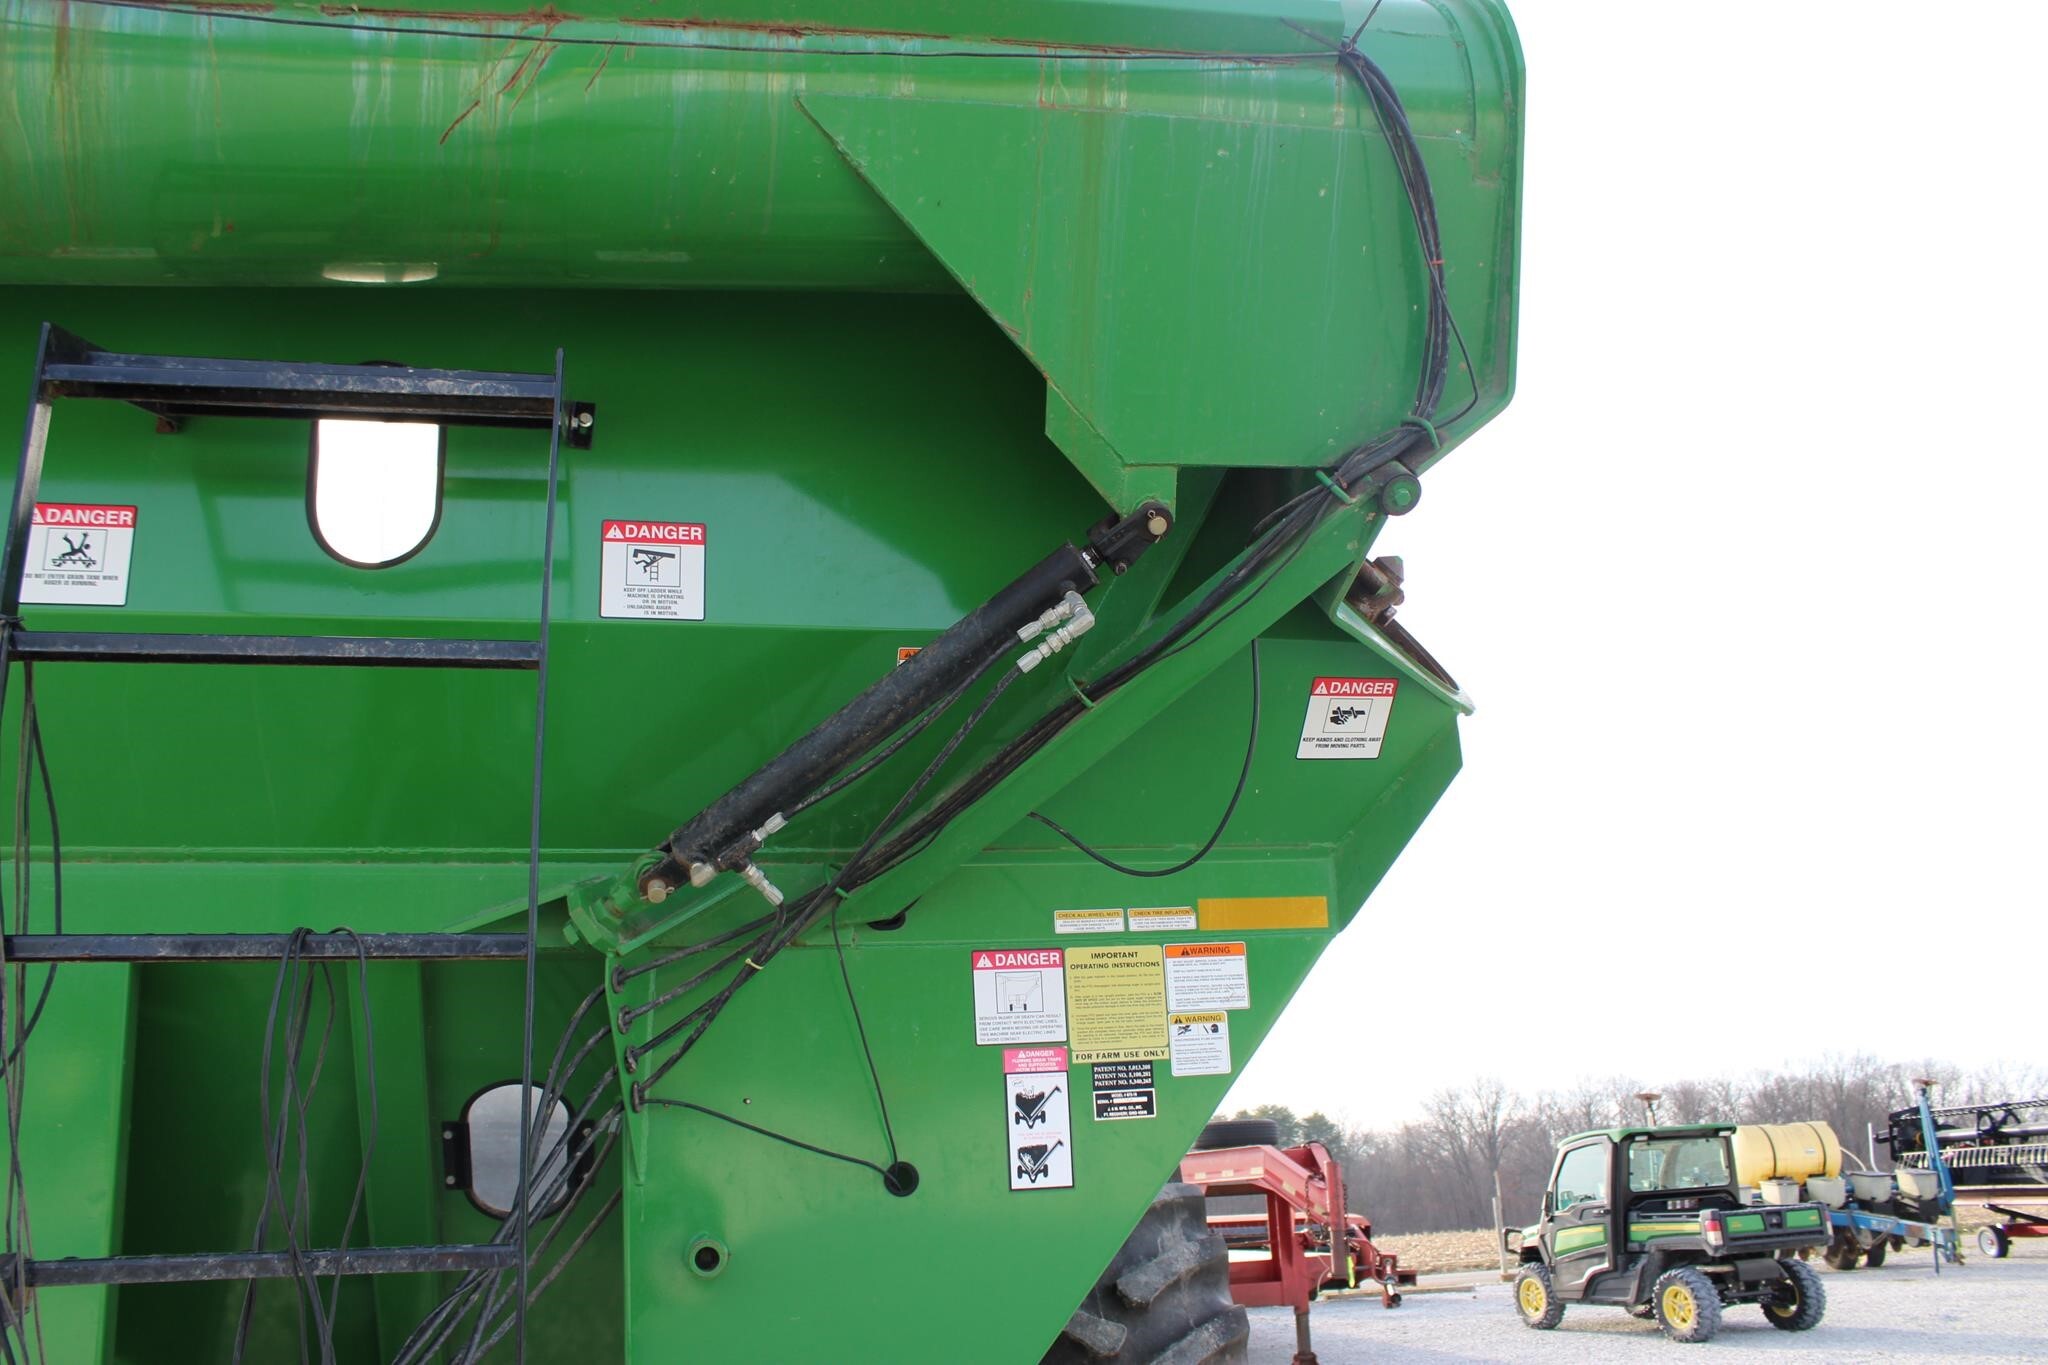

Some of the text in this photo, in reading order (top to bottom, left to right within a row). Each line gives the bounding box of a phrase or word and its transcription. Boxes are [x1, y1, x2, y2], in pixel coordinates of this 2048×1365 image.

[46, 508, 133, 525] DANGER
[625, 525, 702, 540] DANGER
[1330, 682, 1394, 694] DANGER
[1190, 946, 1231, 955] WARNING
[995, 953, 1060, 966] DANGER
[1184, 1015, 1222, 1023] WARNING
[1124, 1050, 1140, 1058] USE
